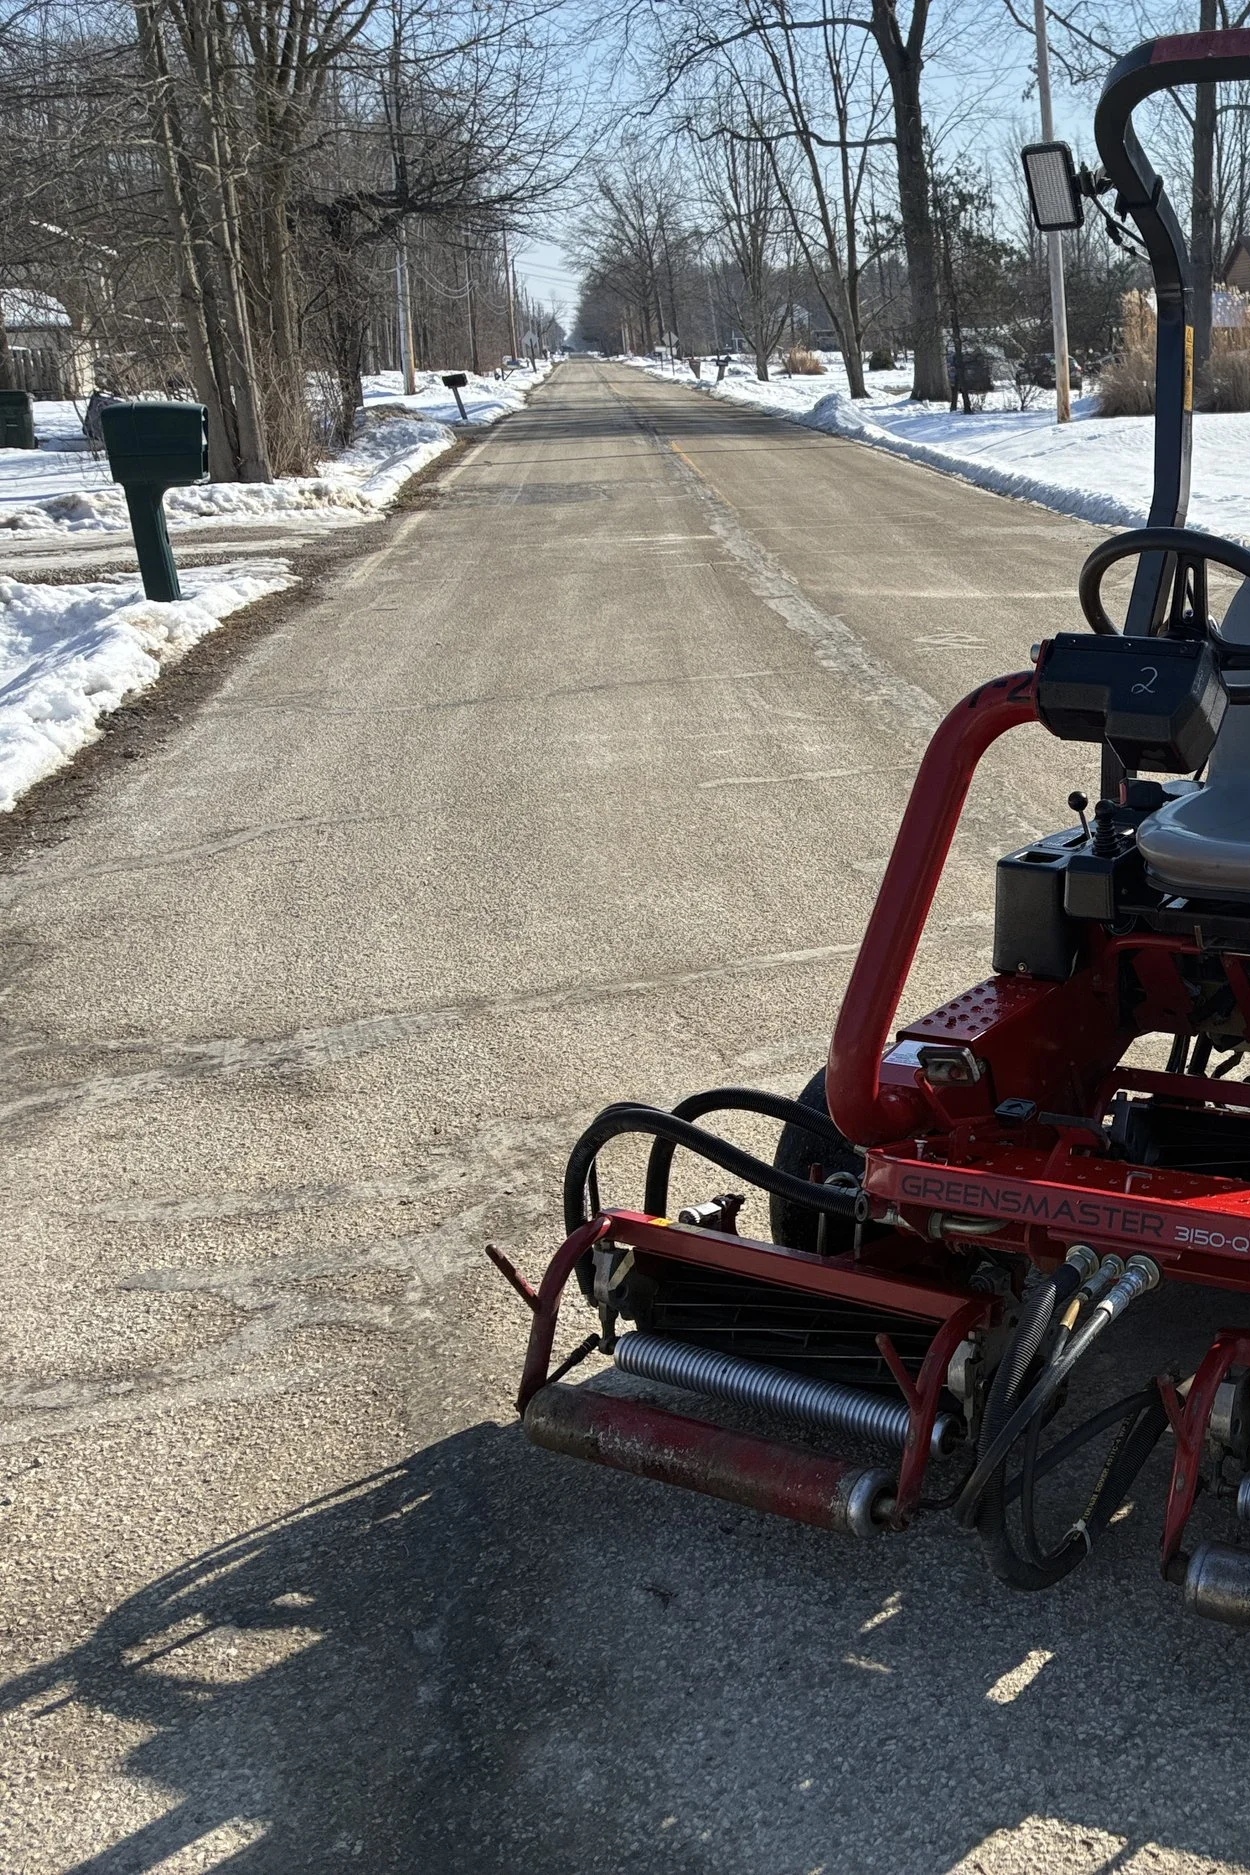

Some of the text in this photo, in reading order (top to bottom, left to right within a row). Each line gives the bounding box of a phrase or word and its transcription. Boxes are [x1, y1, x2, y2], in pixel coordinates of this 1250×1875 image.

[1131, 666, 1158, 694] 2
[901, 1175, 1250, 1252] GREENSMASTER 3150-Q
